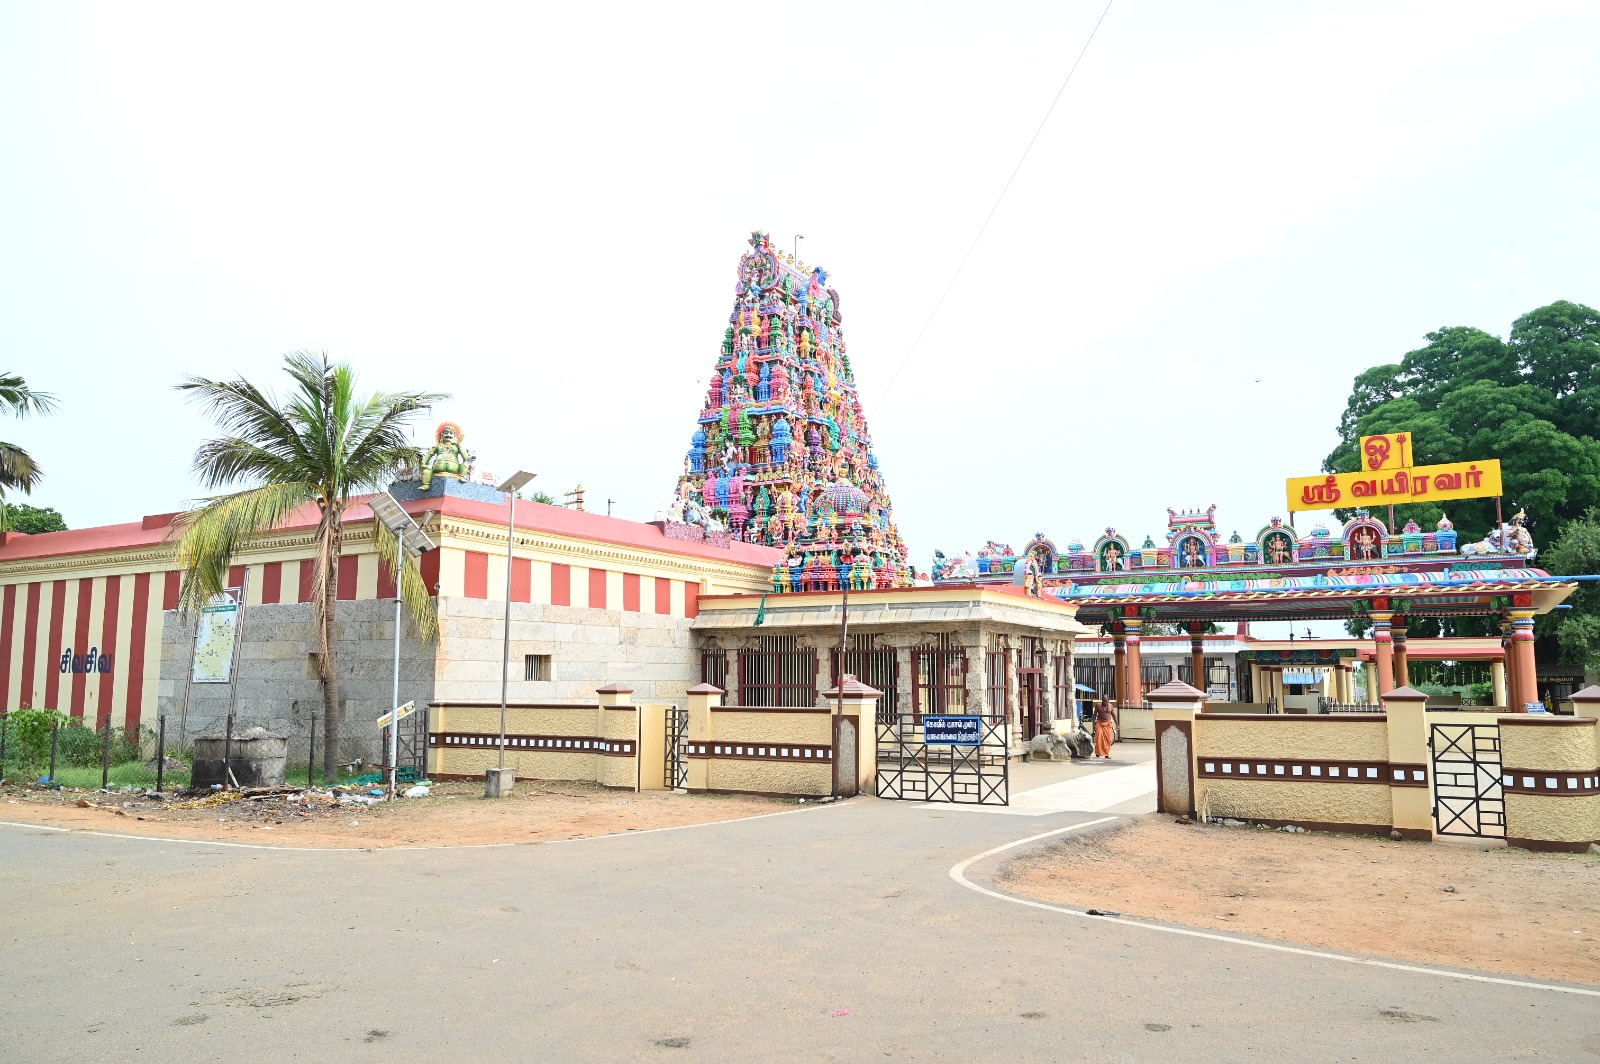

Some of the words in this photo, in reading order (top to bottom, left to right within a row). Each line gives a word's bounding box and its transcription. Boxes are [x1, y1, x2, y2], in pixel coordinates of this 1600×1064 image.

[1301, 475, 1341, 504] ஸ்ரீ
[1351, 464, 1483, 497] வயிரவர்
[60, 647, 112, 673] சிவசிவ
